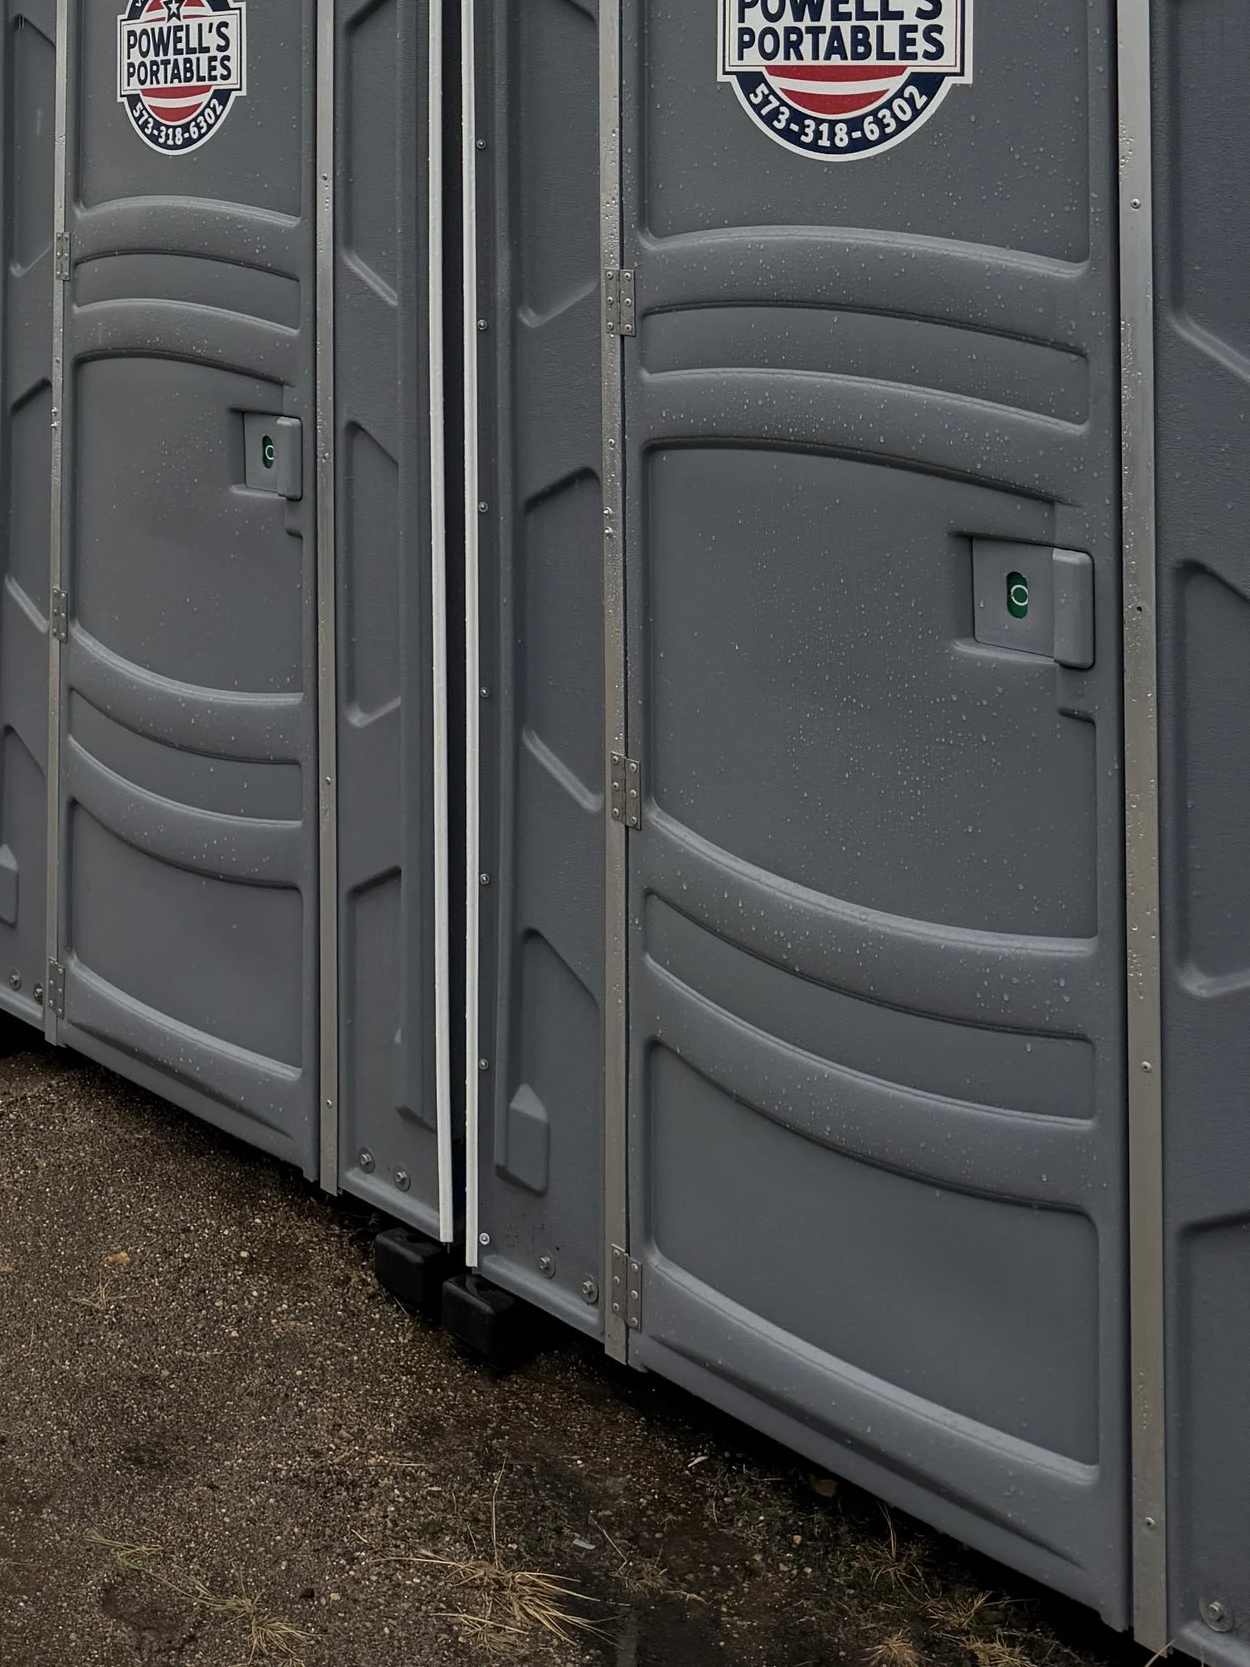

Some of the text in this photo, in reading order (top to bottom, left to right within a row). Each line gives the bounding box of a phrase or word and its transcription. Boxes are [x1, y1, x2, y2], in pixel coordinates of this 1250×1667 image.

[126, 21, 231, 60] POWELL'S
[737, 24, 945, 62] PORTABLES
[126, 55, 232, 87] PORTABLES
[132, 97, 224, 146] 573-318-6302
[748, 84, 928, 149] 573-318-6302
